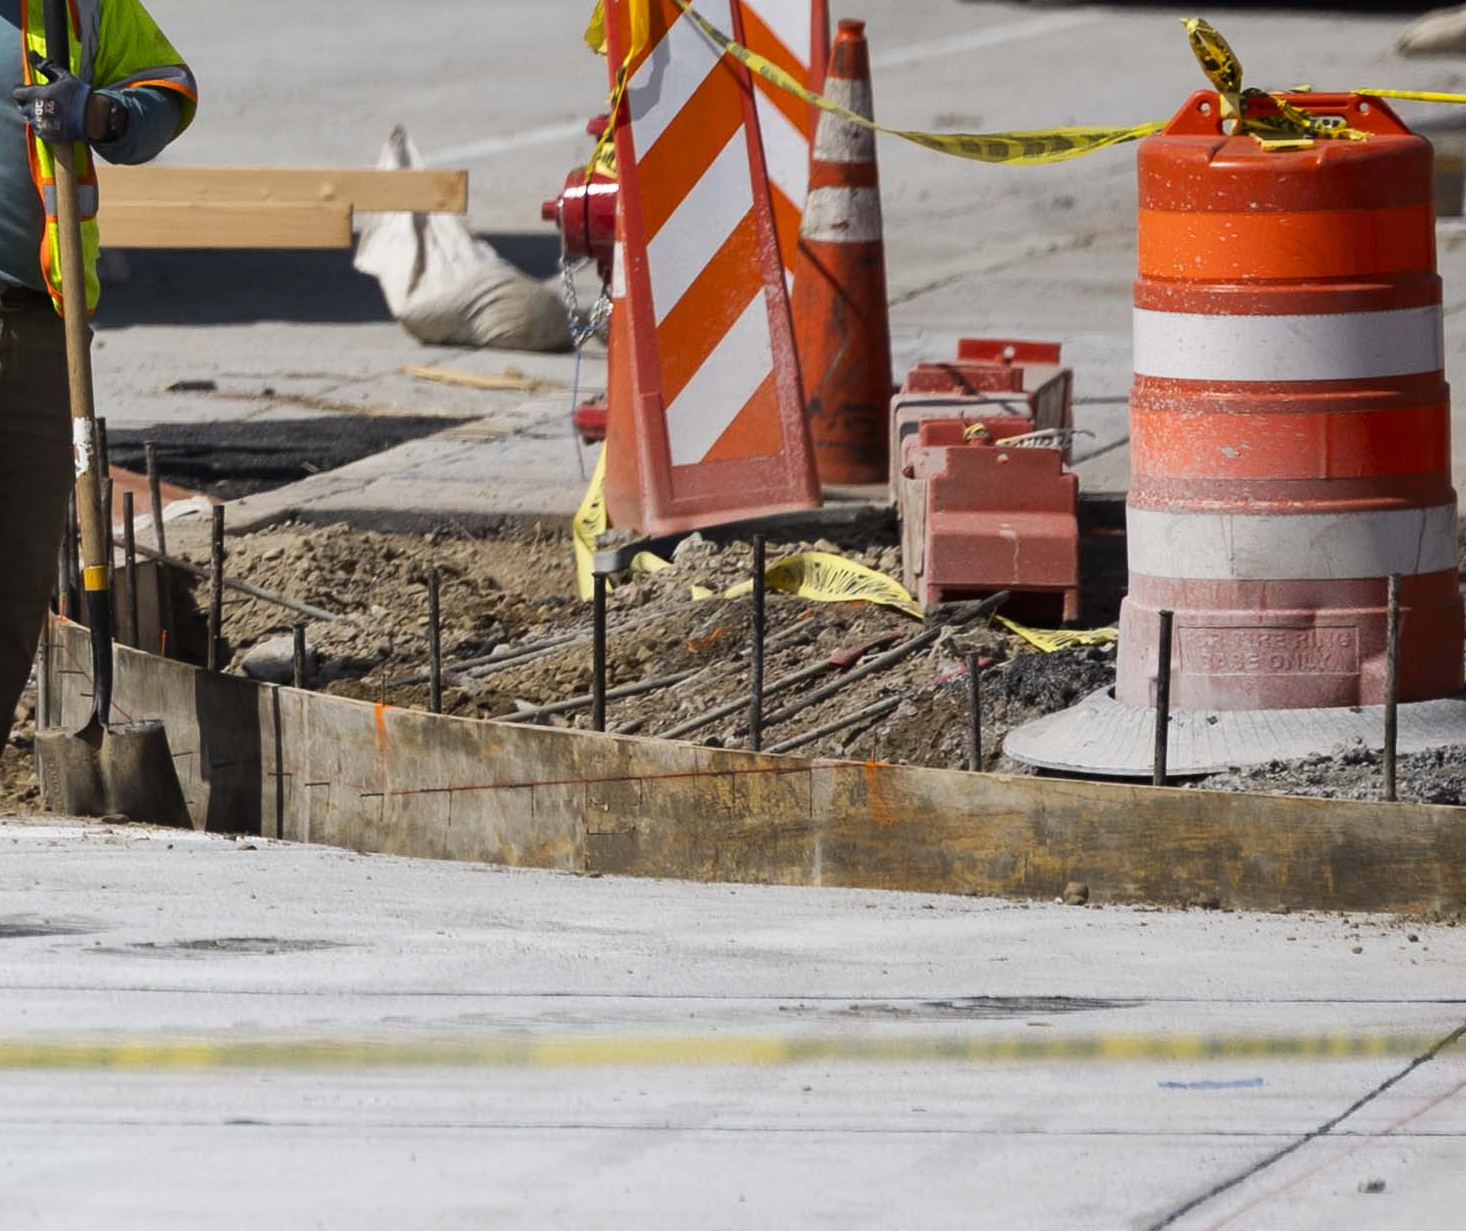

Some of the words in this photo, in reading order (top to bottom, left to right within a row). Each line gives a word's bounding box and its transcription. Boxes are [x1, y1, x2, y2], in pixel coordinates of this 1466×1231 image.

[1294, 632, 1351, 649] RING
[1200, 653, 1260, 670] BASE
[1270, 653, 1332, 671] ONLY
